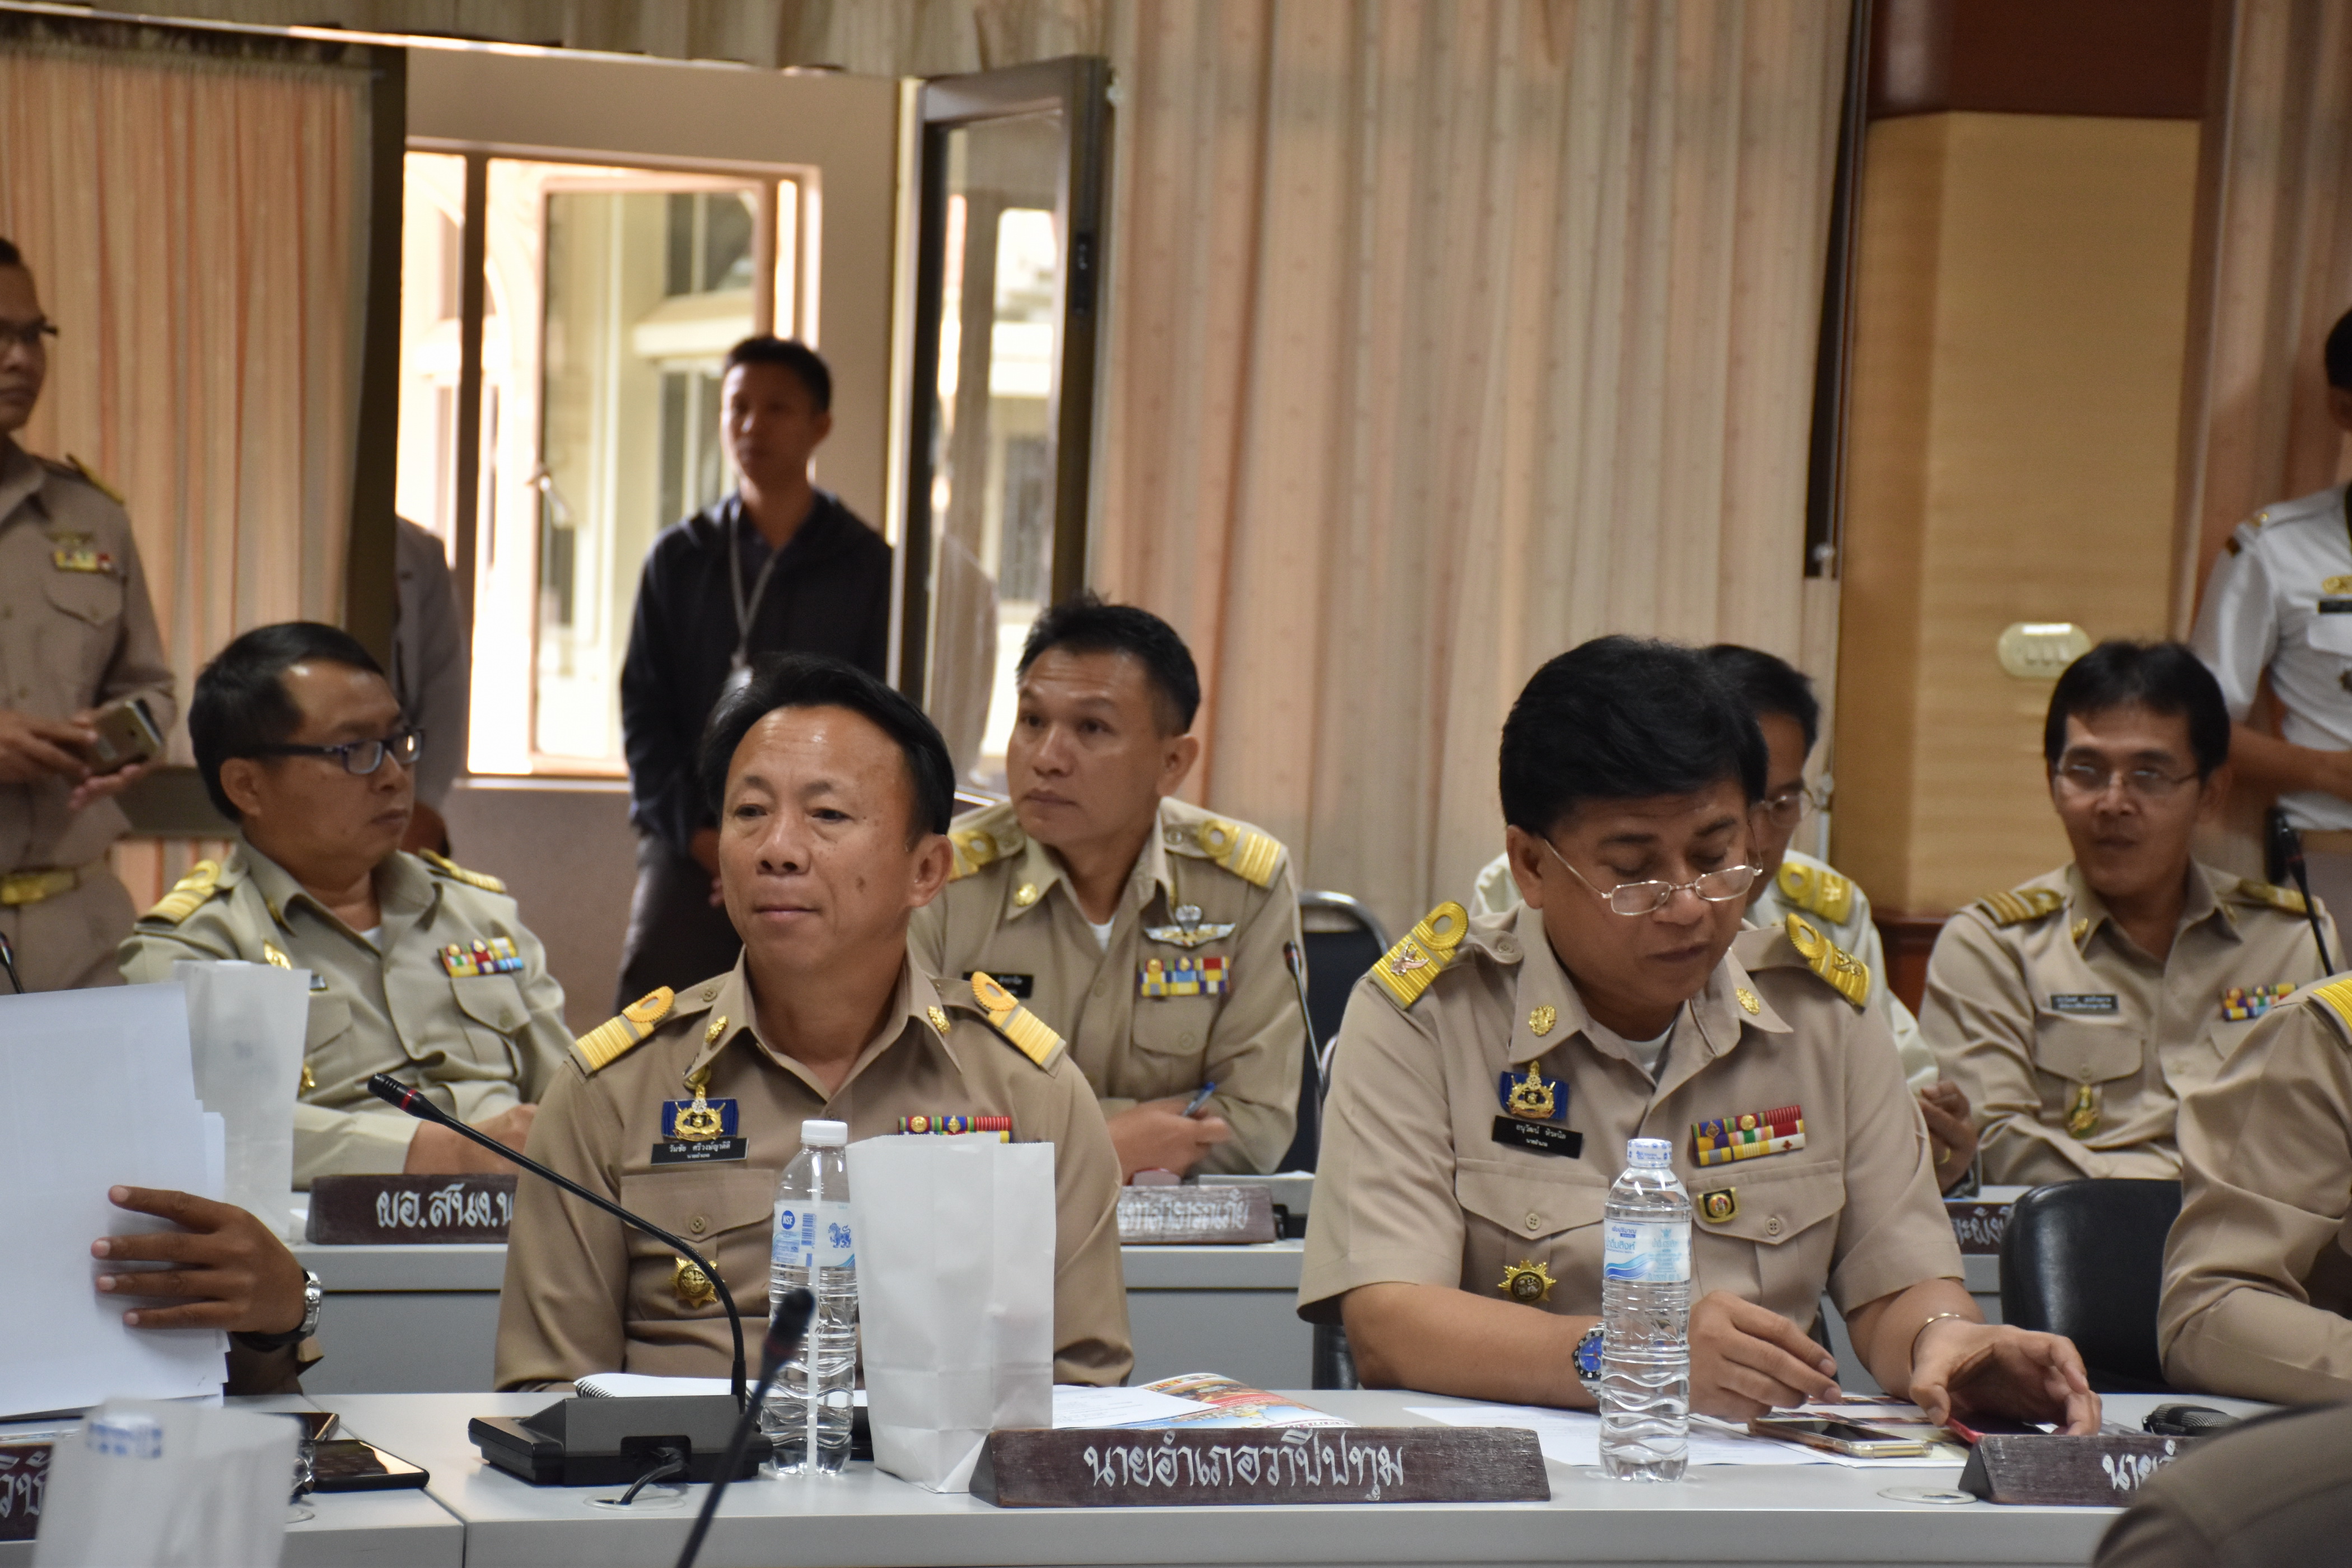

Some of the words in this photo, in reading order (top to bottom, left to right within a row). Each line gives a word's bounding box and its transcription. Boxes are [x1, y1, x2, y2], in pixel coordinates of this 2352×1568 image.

[783, 1215, 793, 1225] NSF
[1083, 1427, 1404, 1501] นายอำเภอวาปีปทุม
